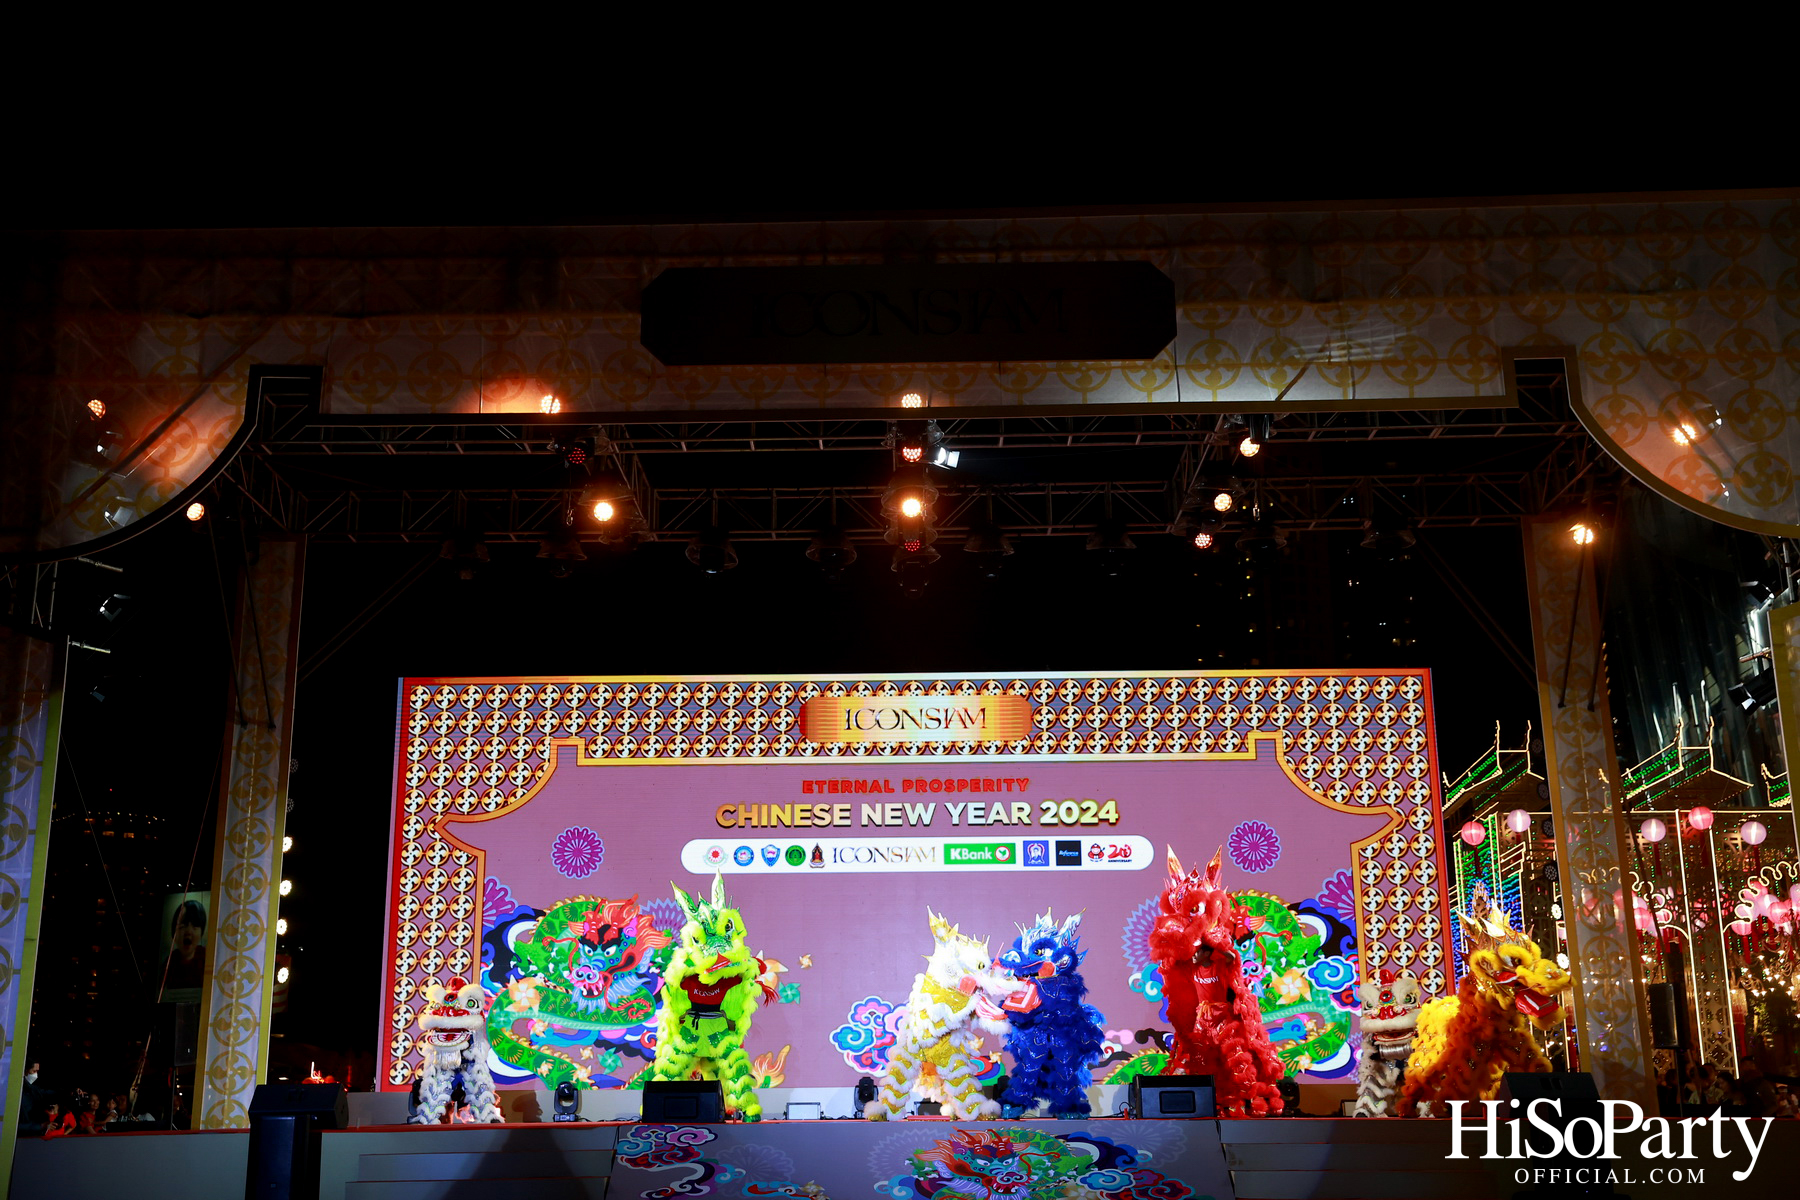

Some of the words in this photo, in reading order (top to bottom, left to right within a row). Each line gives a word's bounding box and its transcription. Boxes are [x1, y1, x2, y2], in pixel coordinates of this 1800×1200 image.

[750, 287, 1068, 339] ICONSIAM
[844, 706, 988, 731] ICONSIAM
[802, 779, 895, 794] ETERNAL
[902, 778, 1029, 793] PROSPERITY
[715, 803, 852, 828] CHINESE
[861, 802, 937, 827] NEW
[944, 802, 1033, 826] YEAR
[1039, 801, 1119, 825] 2024
[833, 846, 936, 865] ICONSIAM
[950, 847, 992, 861] KBank
